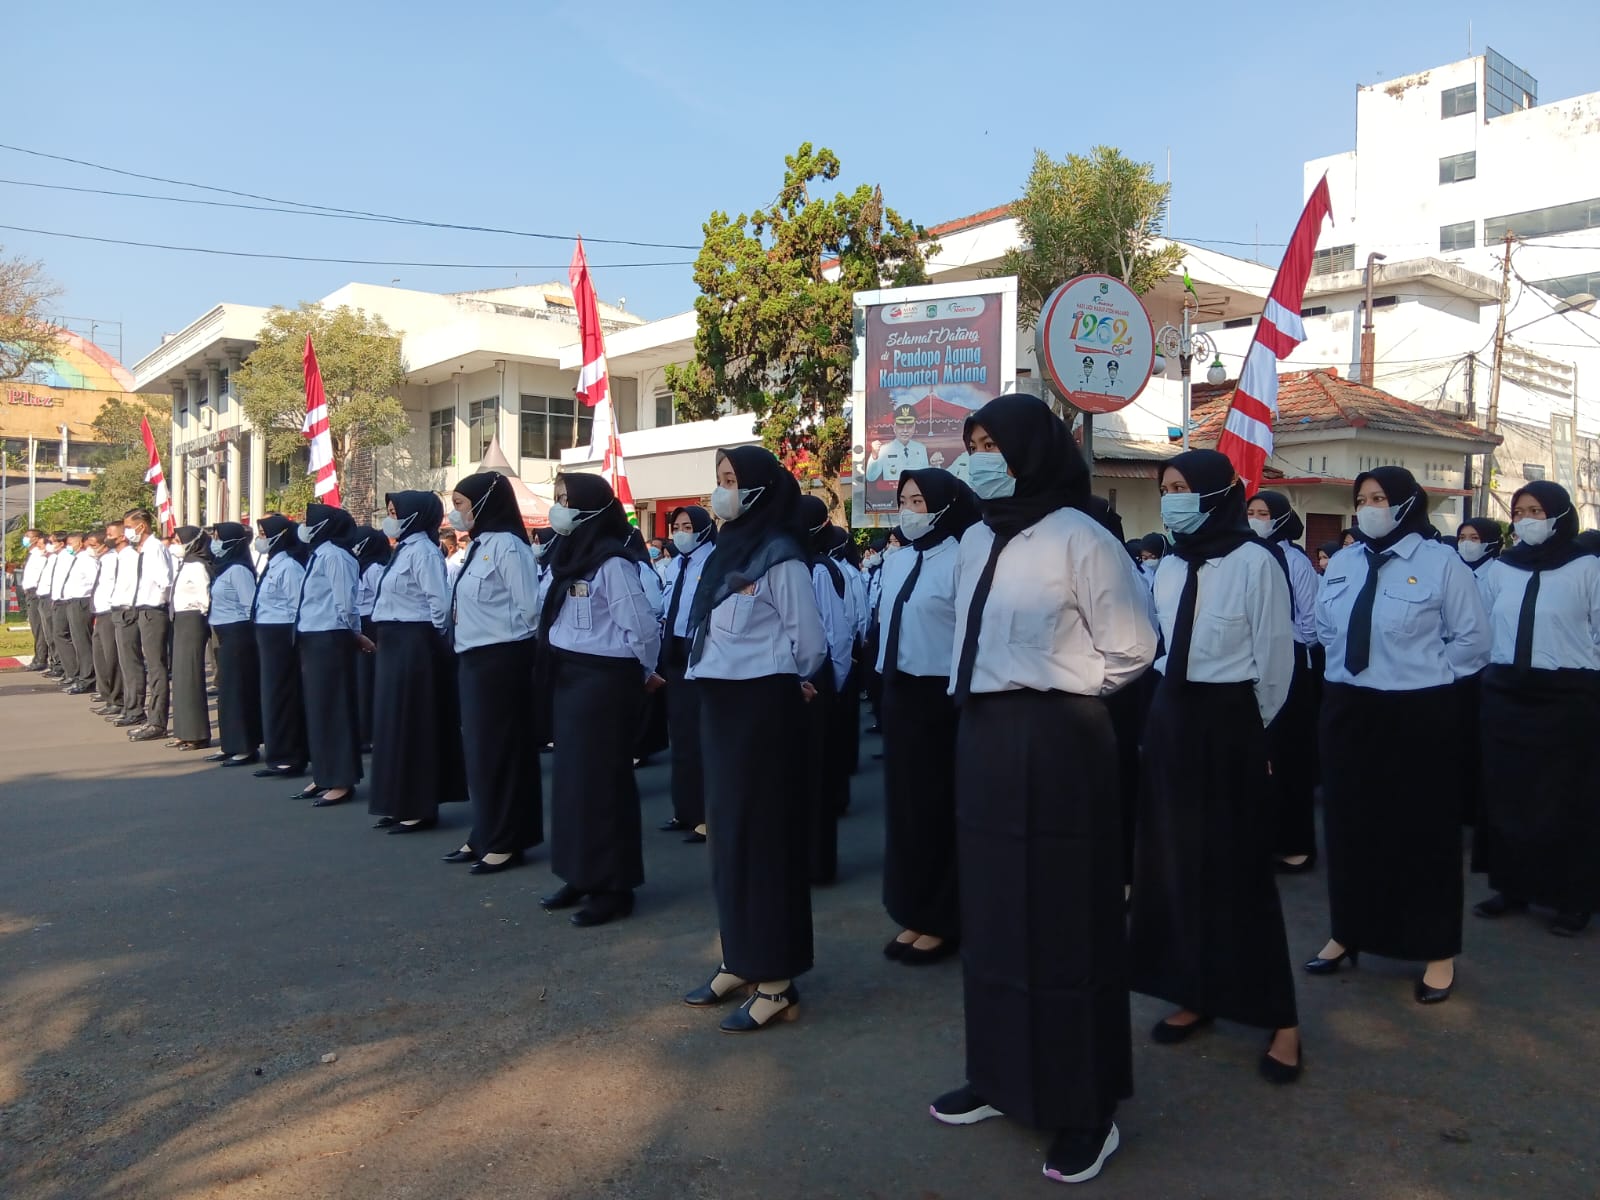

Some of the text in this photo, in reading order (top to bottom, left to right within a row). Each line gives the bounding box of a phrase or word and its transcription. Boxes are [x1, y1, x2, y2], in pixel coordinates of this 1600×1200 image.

[886, 327, 980, 347] Selamat Datang
[881, 345, 981, 369] di Pendopo Agung
[879, 364, 987, 388] Kabupaten Malang
